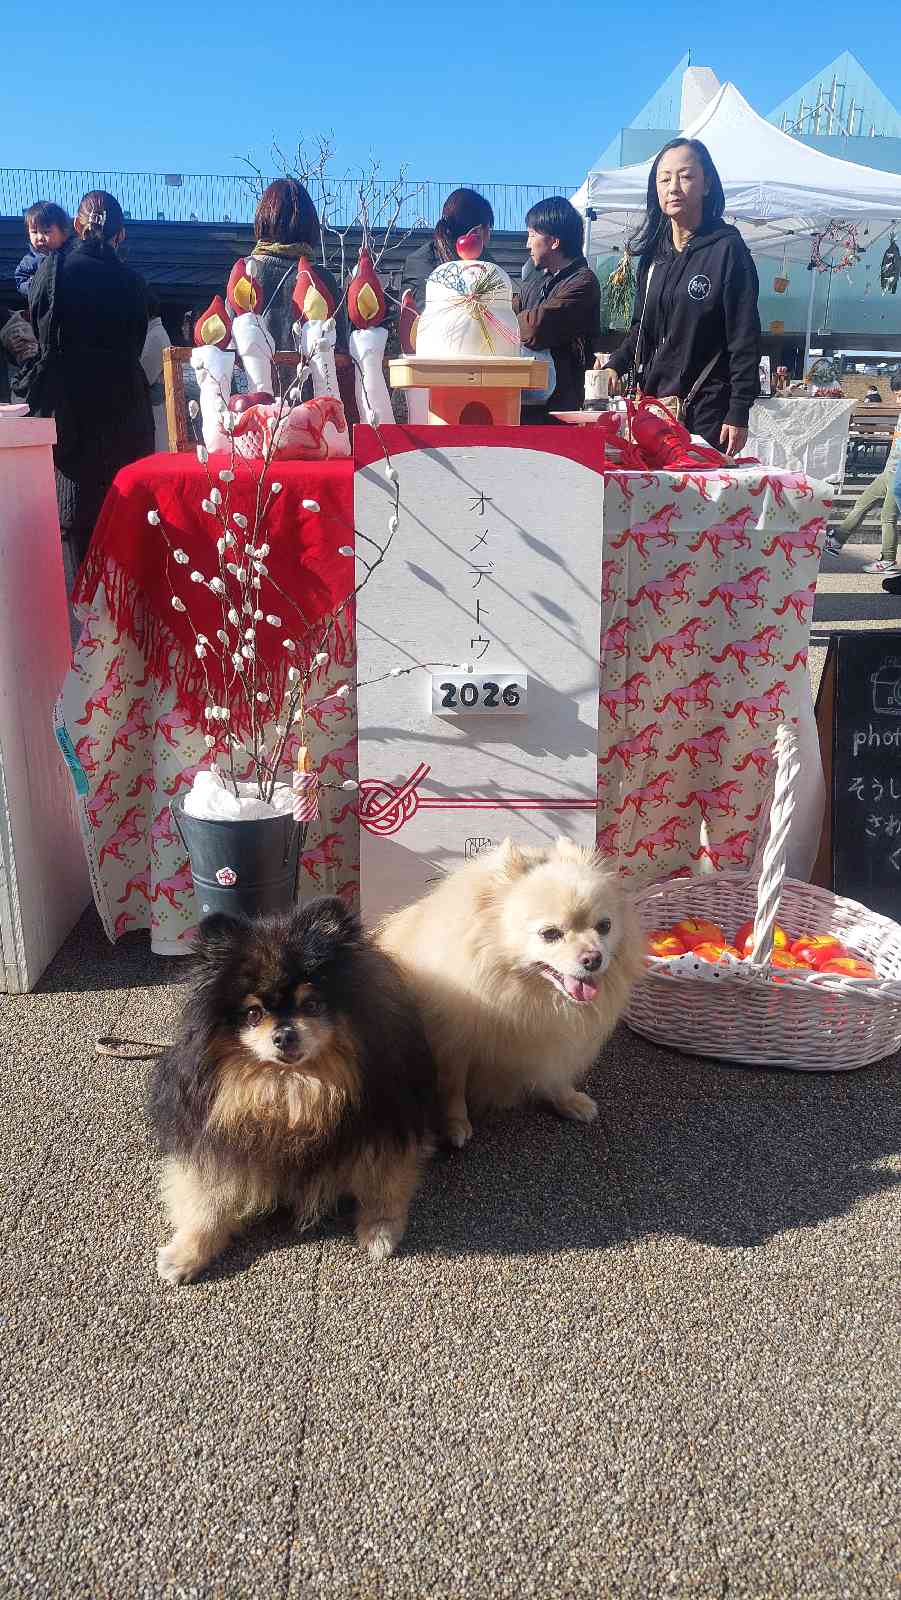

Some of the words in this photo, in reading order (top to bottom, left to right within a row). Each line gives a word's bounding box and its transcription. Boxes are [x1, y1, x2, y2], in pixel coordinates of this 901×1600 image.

[467, 490, 495, 660] オメデトウ
[439, 682, 520, 708] 2026
